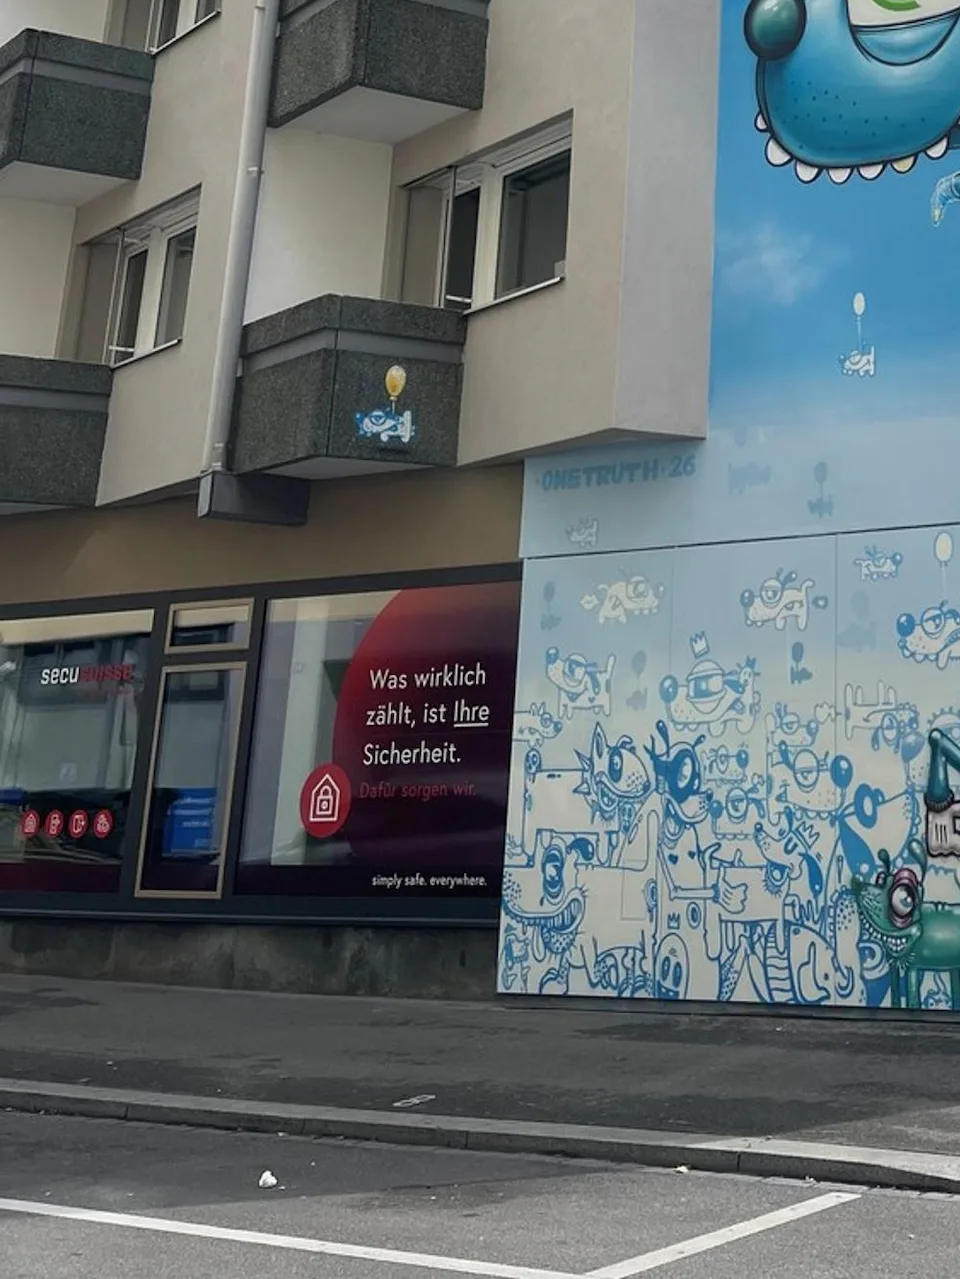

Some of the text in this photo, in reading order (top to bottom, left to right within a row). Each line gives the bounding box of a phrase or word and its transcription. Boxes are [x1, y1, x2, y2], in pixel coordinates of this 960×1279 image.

[668, 454, 697, 478] 26
[369, 662, 486, 690] Was wirklich
[366, 699, 490, 728] zählt, ist Ihre
[362, 740, 461, 765] Sicherheit.
[359, 780, 476, 801] Dafür sorgen wir.
[372, 872, 487, 889] simply safe. everywhere.
